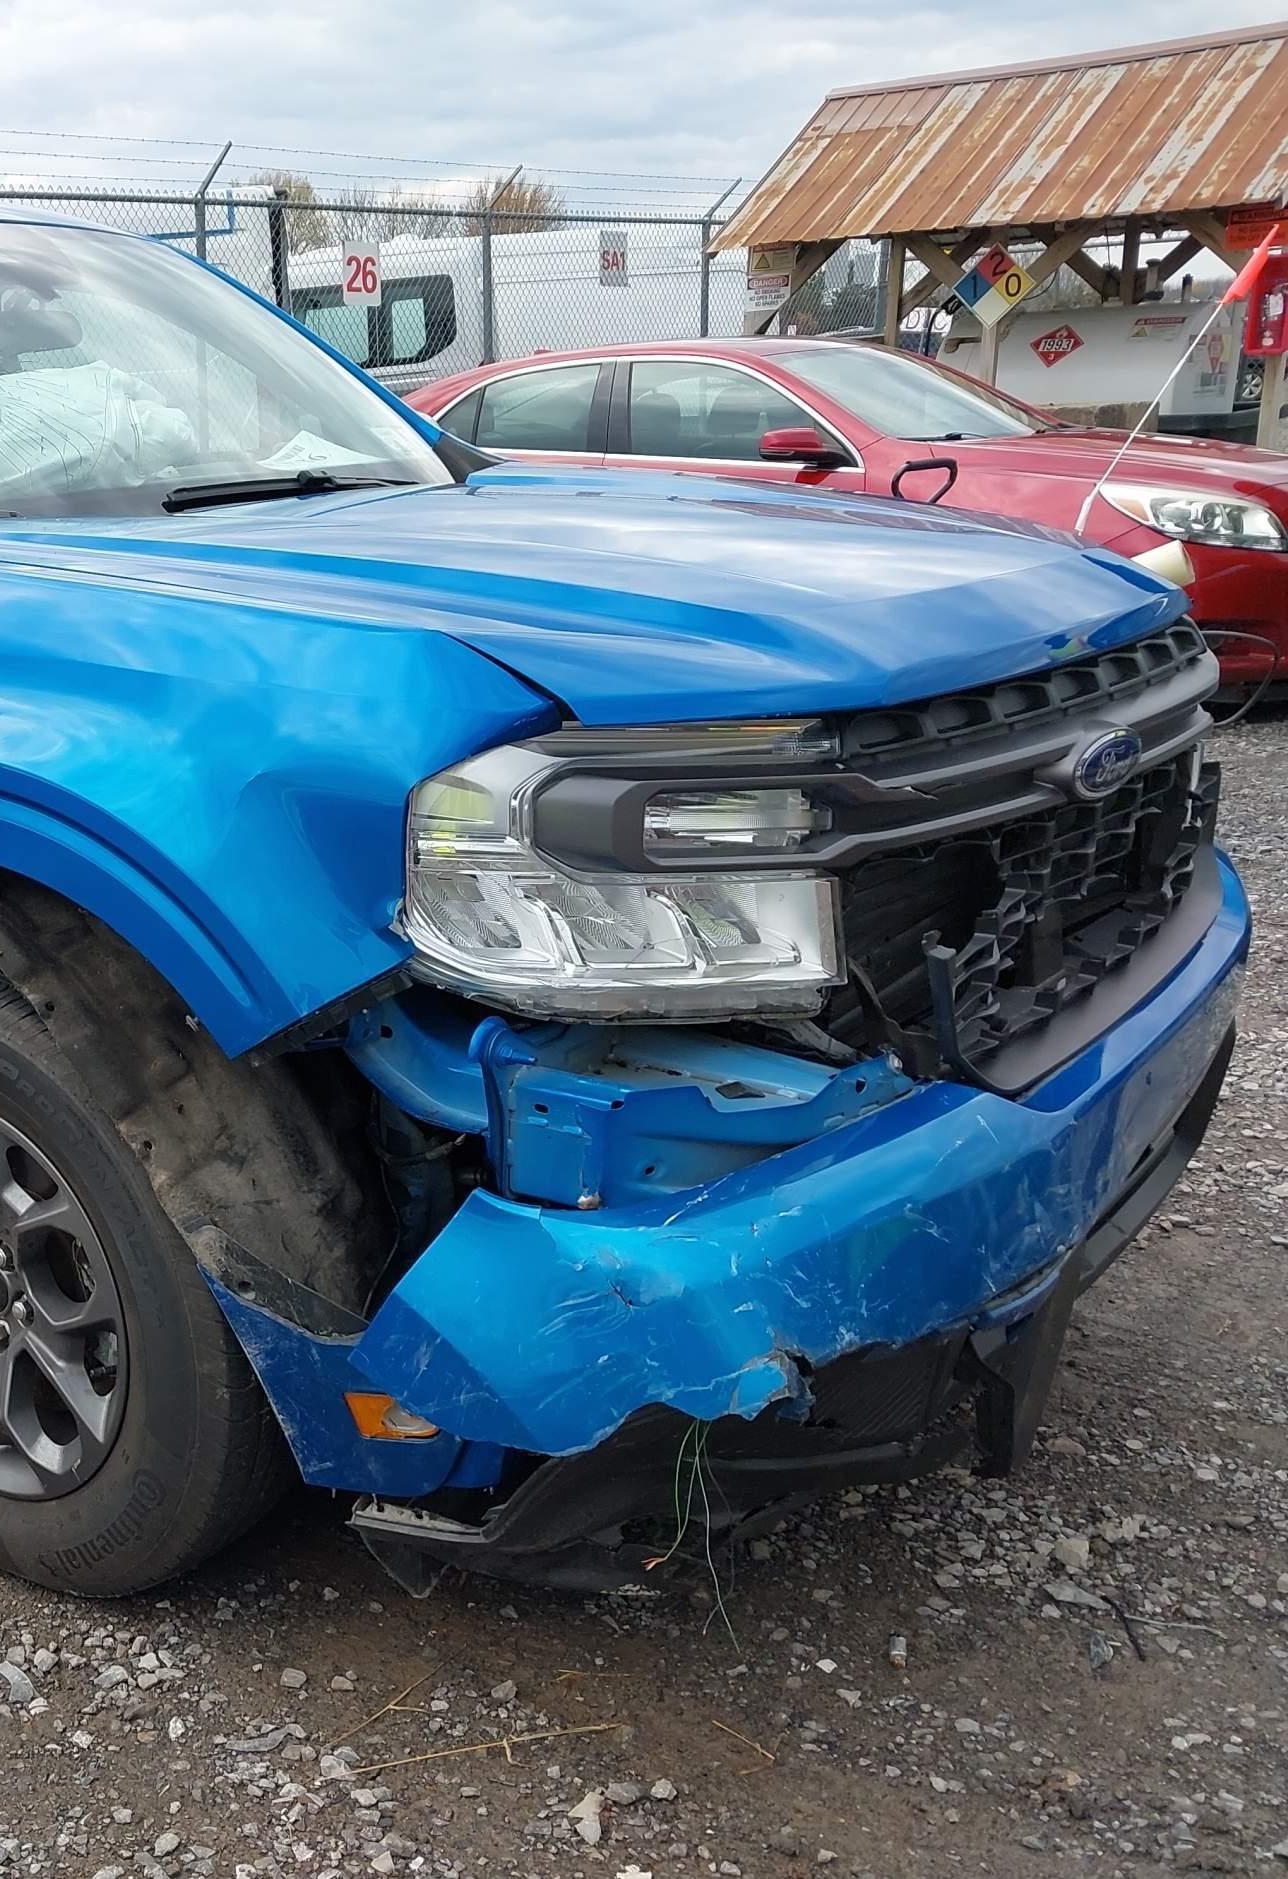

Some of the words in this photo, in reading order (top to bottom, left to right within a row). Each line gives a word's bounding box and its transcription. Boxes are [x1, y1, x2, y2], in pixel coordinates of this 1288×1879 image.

[603, 250, 625, 271] SA1
[990, 252, 1008, 277] 2
[346, 255, 377, 293] 26
[1004, 273, 1021, 297] 0
[972, 275, 977, 298] 1
[1042, 339, 1072, 351] 1993
[1095, 744, 1134, 782] Ford
